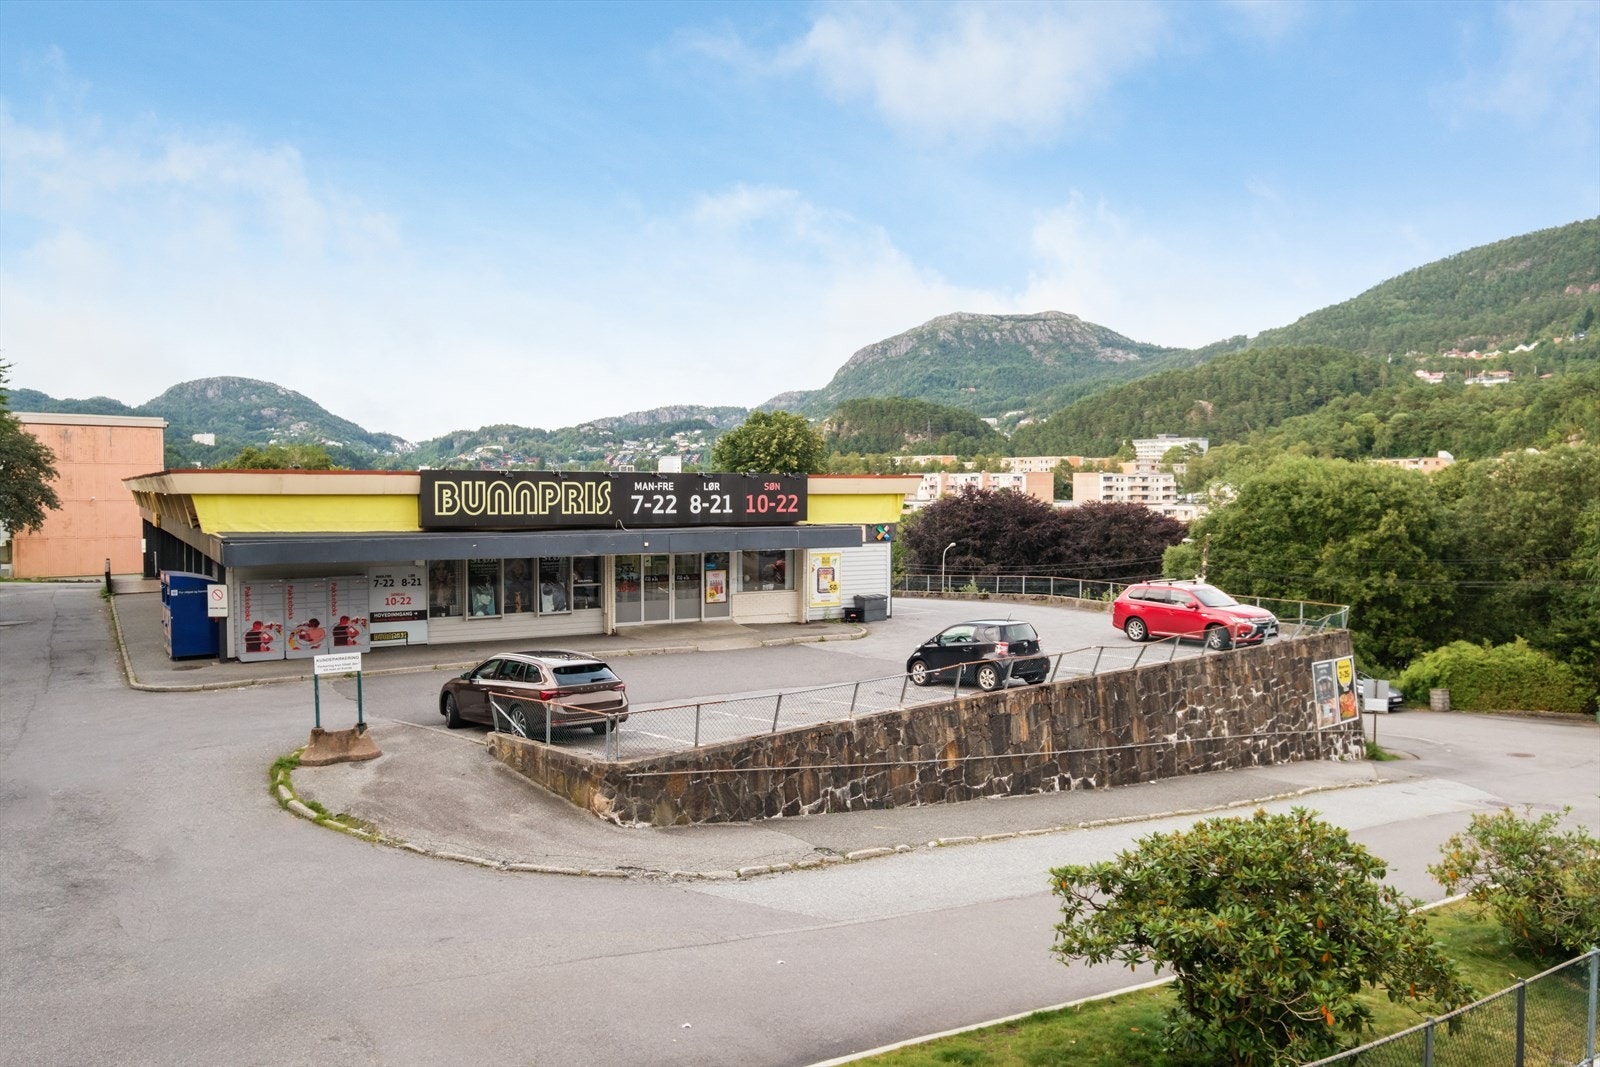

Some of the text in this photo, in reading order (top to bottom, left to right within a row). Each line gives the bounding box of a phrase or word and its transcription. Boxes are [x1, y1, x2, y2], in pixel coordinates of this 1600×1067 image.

[634, 481, 781, 491] MAN-FRE LØR SØN
[434, 480, 611, 516] BUNNPRIS
[630, 494, 799, 515] 7-22 8-21 10-22
[373, 578, 422, 588] 7-22 8-21
[384, 596, 412, 606] 10-22
[316, 655, 360, 663] KUNDEPARKERING
